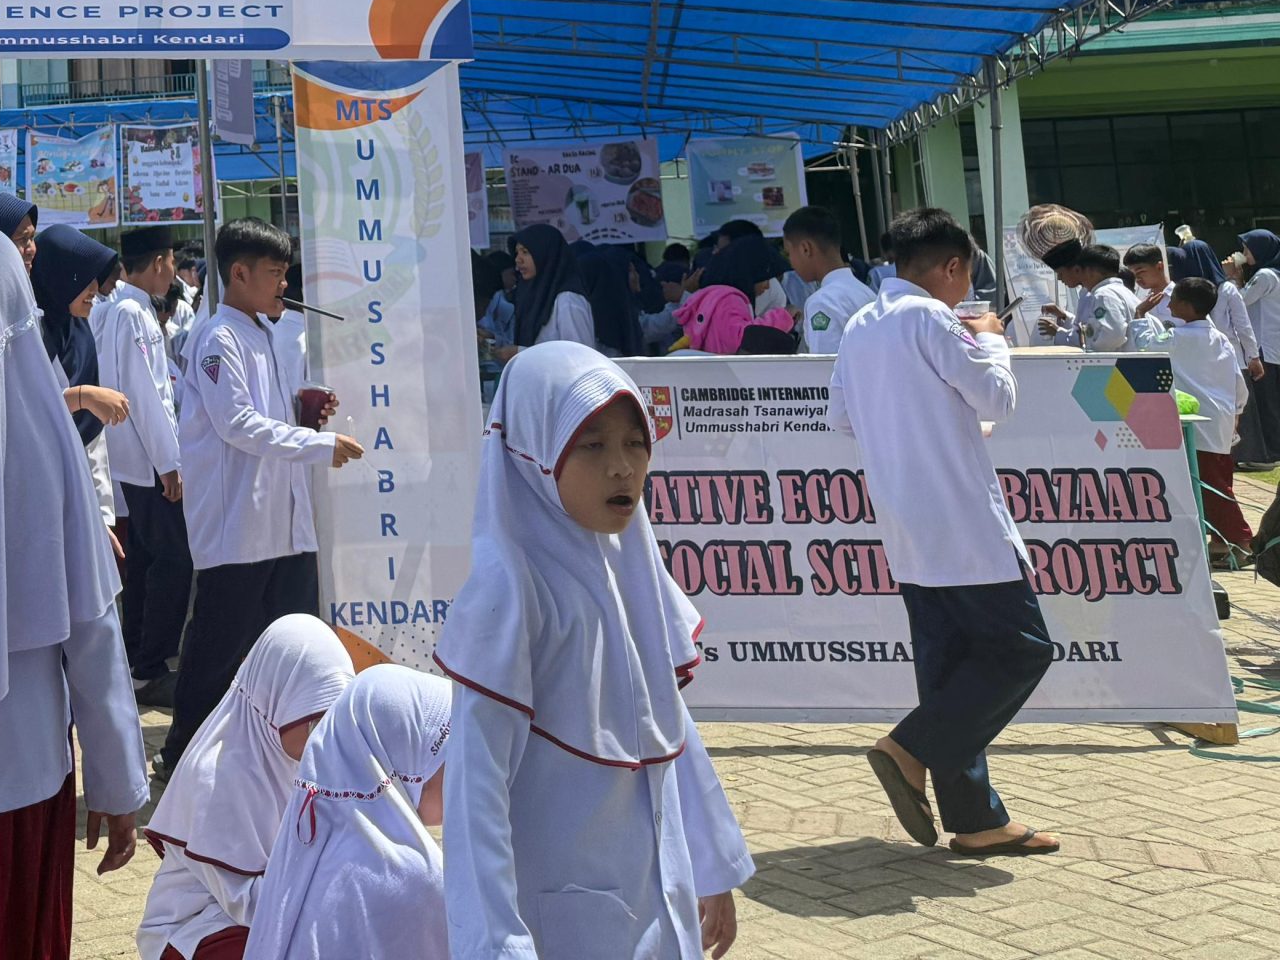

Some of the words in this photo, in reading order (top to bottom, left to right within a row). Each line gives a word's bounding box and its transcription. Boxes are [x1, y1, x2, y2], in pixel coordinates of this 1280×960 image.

[120, 5, 284, 19] PROJECT
[154, 33, 245, 44] Kendari
[336, 99, 392, 121] MTS
[511, 166, 539, 177] STAND
[548, 163, 560, 175] AR
[563, 163, 581, 173] DUA
[681, 387, 756, 401] CAMBRIDGE
[758, 386, 829, 401] INTERNATIO
[683, 405, 749, 417] Madrasah
[685, 421, 780, 433] Ummusshabri
[784, 421, 835, 432] Kenda
[646, 469, 773, 525] ATIVE
[995, 467, 1172, 523] BAZAAR
[657, 539, 803, 596] OCIAL
[807, 539, 904, 596] SCIE
[1023, 537, 1183, 603] ROJECT
[330, 599, 450, 626] KENDAR
[727, 641, 915, 662] UMMUSSHA
[1051, 640, 1123, 662] DARI
